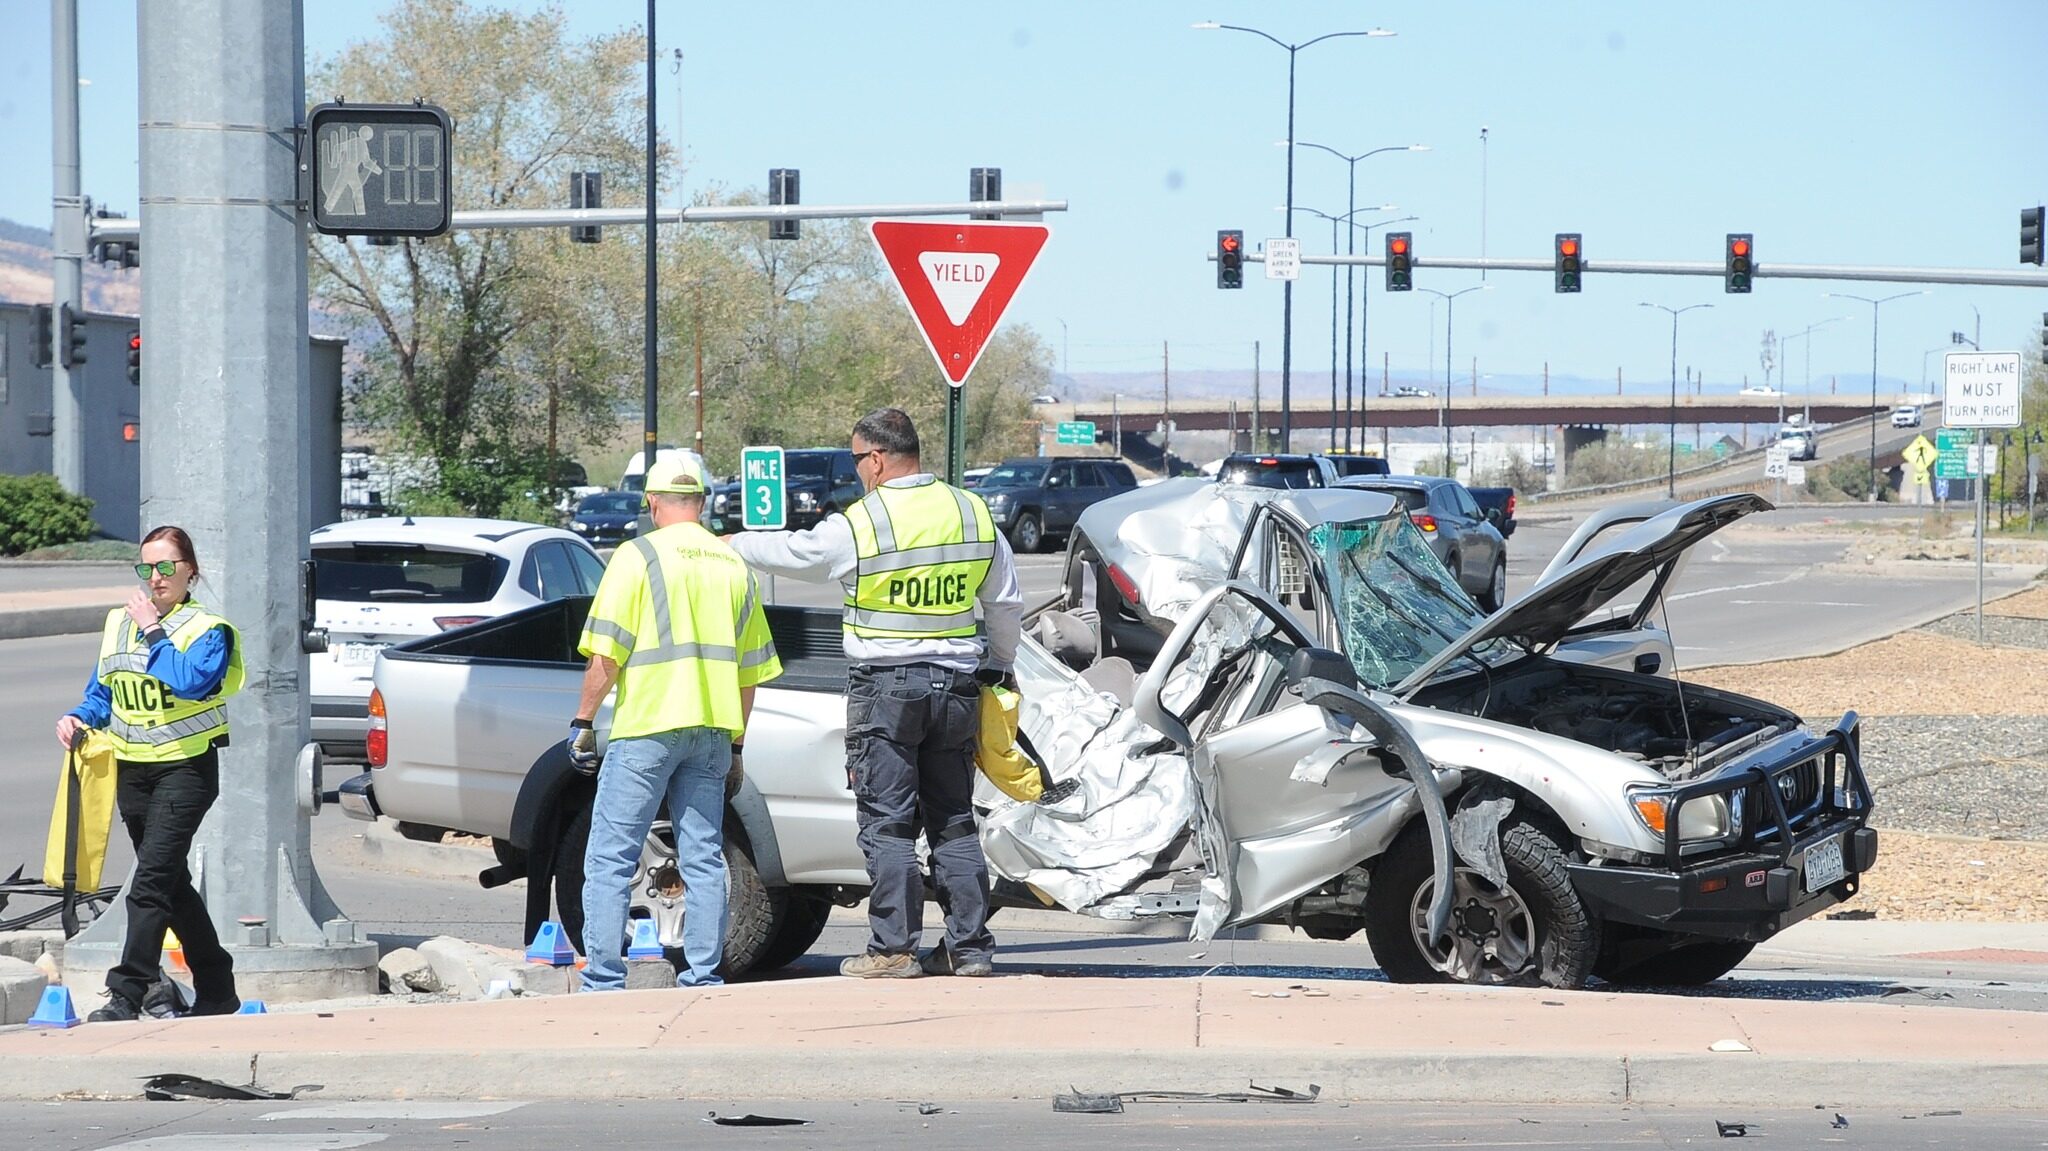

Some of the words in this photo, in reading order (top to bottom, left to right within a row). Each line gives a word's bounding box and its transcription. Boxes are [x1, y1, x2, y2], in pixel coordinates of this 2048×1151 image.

[933, 263, 986, 283] YIELD
[1949, 362, 1982, 375] RIGHT
[1986, 361, 2016, 374] LANE
[1962, 382, 2003, 398] MUST
[1948, 404, 1977, 417] TURN
[1983, 404, 2016, 417] RIGHT
[747, 459, 779, 481] MILE
[1768, 464, 1785, 473] 45
[755, 485, 772, 515] 3
[889, 574, 968, 607] POLICE
[113, 678, 175, 711] OLICE
